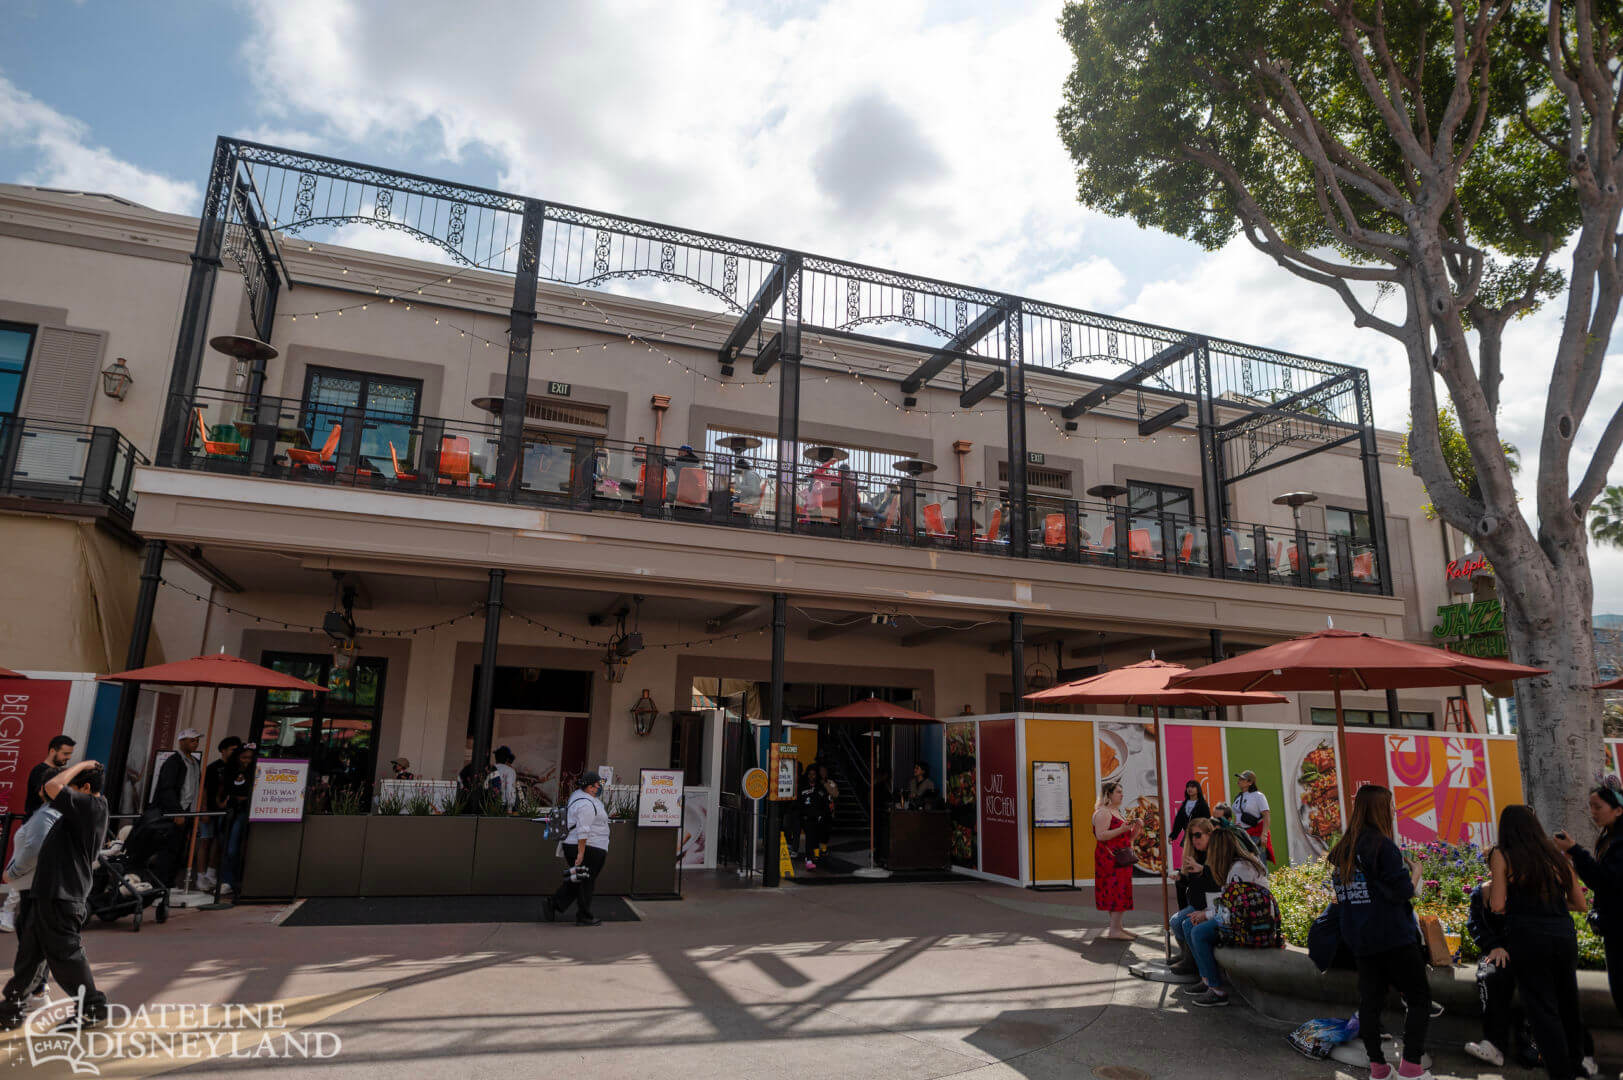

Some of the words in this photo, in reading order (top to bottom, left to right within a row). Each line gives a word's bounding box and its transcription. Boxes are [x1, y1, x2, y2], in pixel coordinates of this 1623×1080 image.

[551, 382, 569, 395] EXIT
[1031, 453, 1044, 463] EXIT
[1432, 599, 1505, 638] JAZZ
[984, 774, 1004, 794] JAZZ
[280, 789, 297, 797] WAY
[254, 806, 279, 814] ENTER
[280, 807, 300, 815] HERE
[986, 795, 1015, 817] KITCHEN
